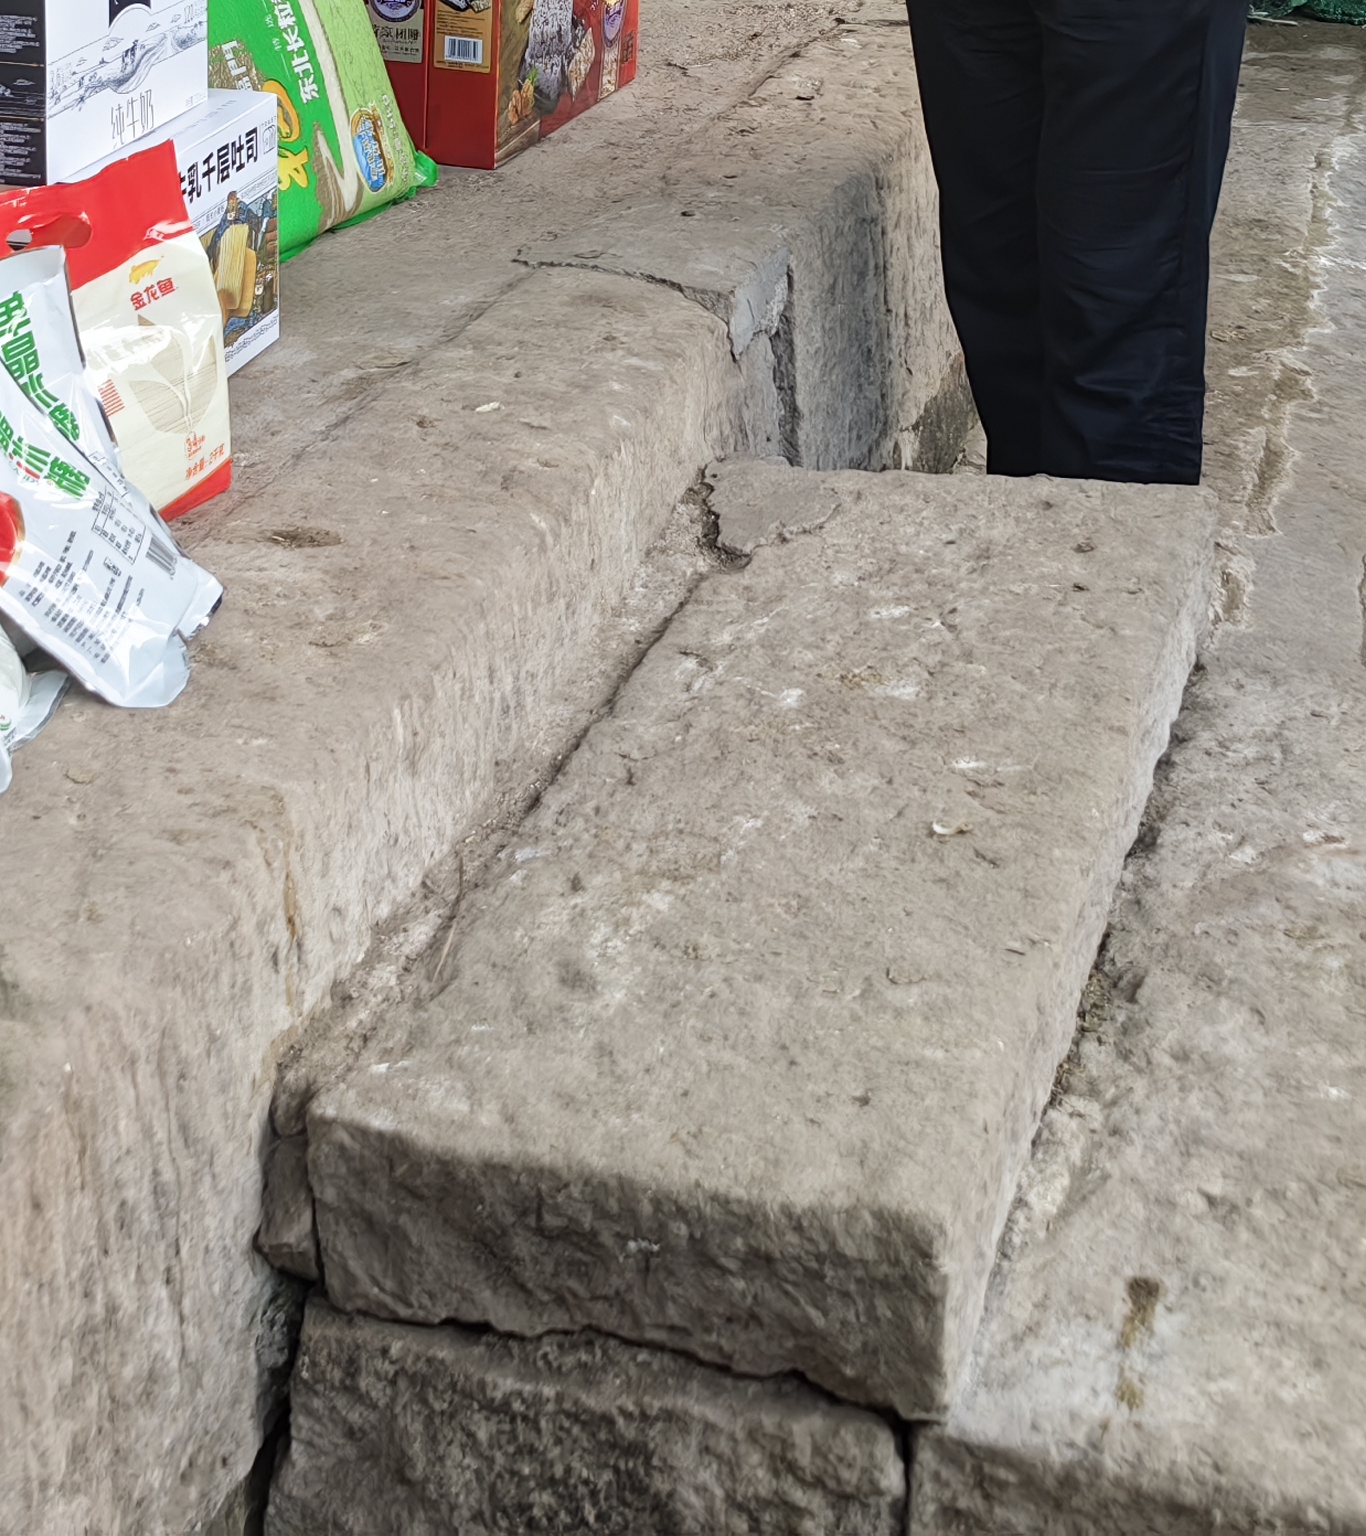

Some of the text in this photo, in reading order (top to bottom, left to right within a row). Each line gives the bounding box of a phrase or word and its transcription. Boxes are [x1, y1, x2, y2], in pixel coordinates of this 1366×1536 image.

[110, 89, 155, 149] 纯牛奶
[130, 277, 177, 311] 金龙鱼
